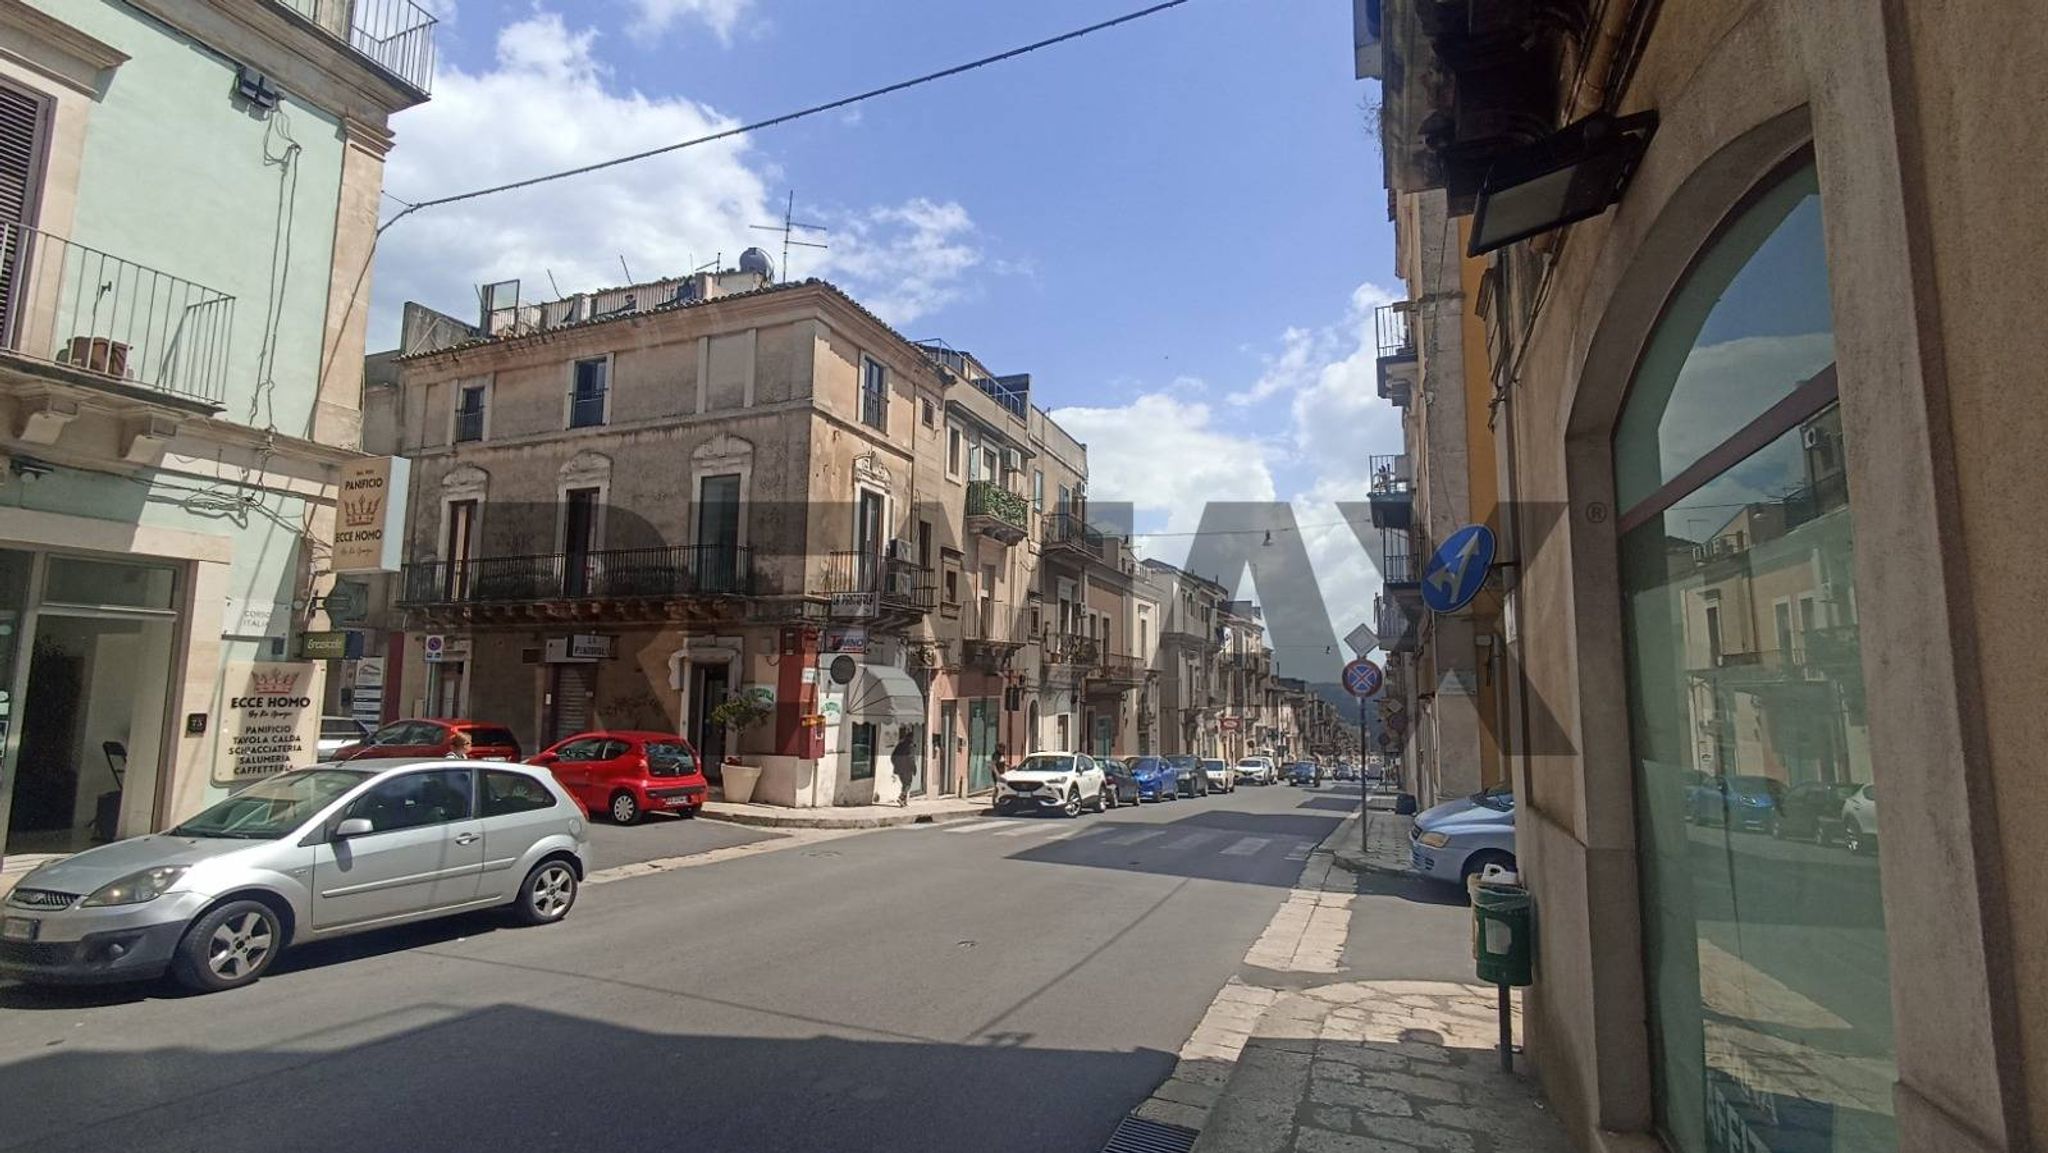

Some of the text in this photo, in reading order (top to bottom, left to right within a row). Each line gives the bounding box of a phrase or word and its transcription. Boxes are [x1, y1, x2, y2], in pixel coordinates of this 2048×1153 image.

[345, 478, 383, 490] PANIFICIO
[336, 529, 381, 542] ECCE HOMO
[231, 697, 311, 708] ECCE HOMO
[245, 725, 291, 735] PANIFICIO
[233, 735, 301, 746] TAVOLA CALDA
[240, 755, 291, 765] SALUMERIA
